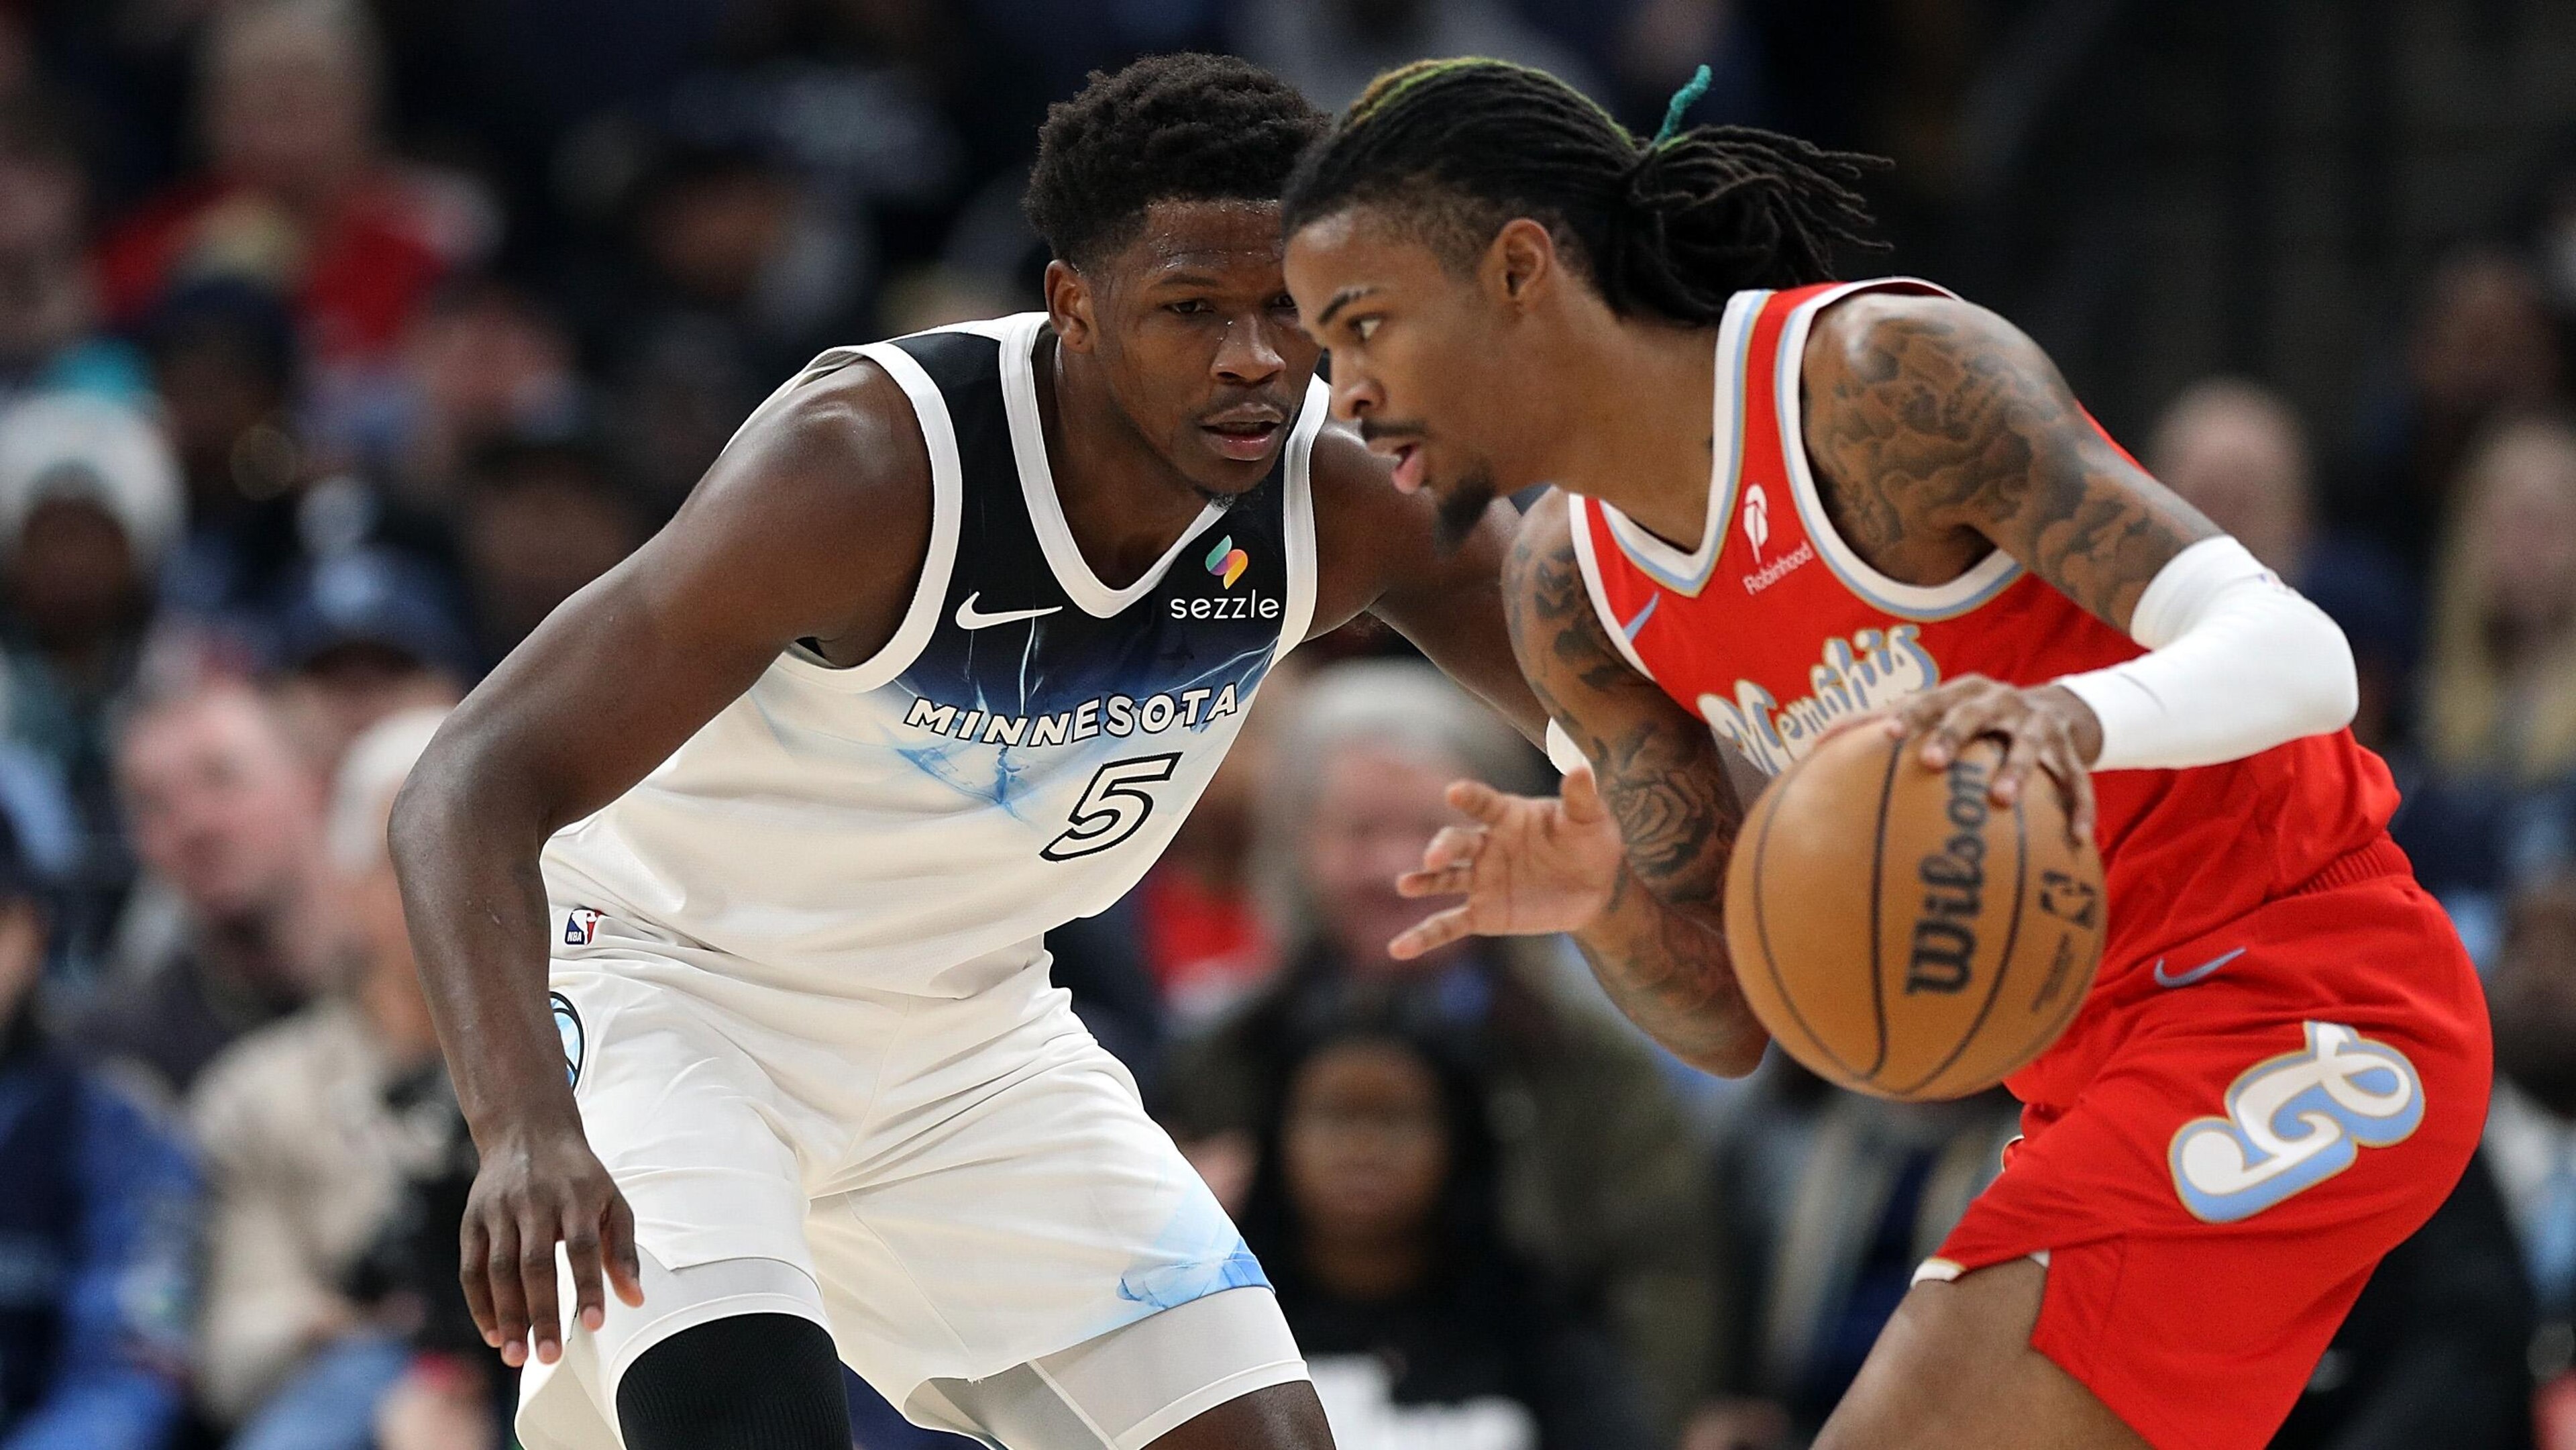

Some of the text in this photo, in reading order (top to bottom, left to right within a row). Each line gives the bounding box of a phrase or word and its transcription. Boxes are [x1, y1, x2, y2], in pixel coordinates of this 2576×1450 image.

[1743, 539, 1813, 595] Robinhood
[1170, 589, 1279, 619] sezzle
[904, 682, 1238, 747] MINNESOTA
[1696, 623, 1941, 776] Memphis
[1039, 752, 1183, 862] 5
[1905, 760, 1988, 994] Wilson
[567, 931, 582, 943] NBA
